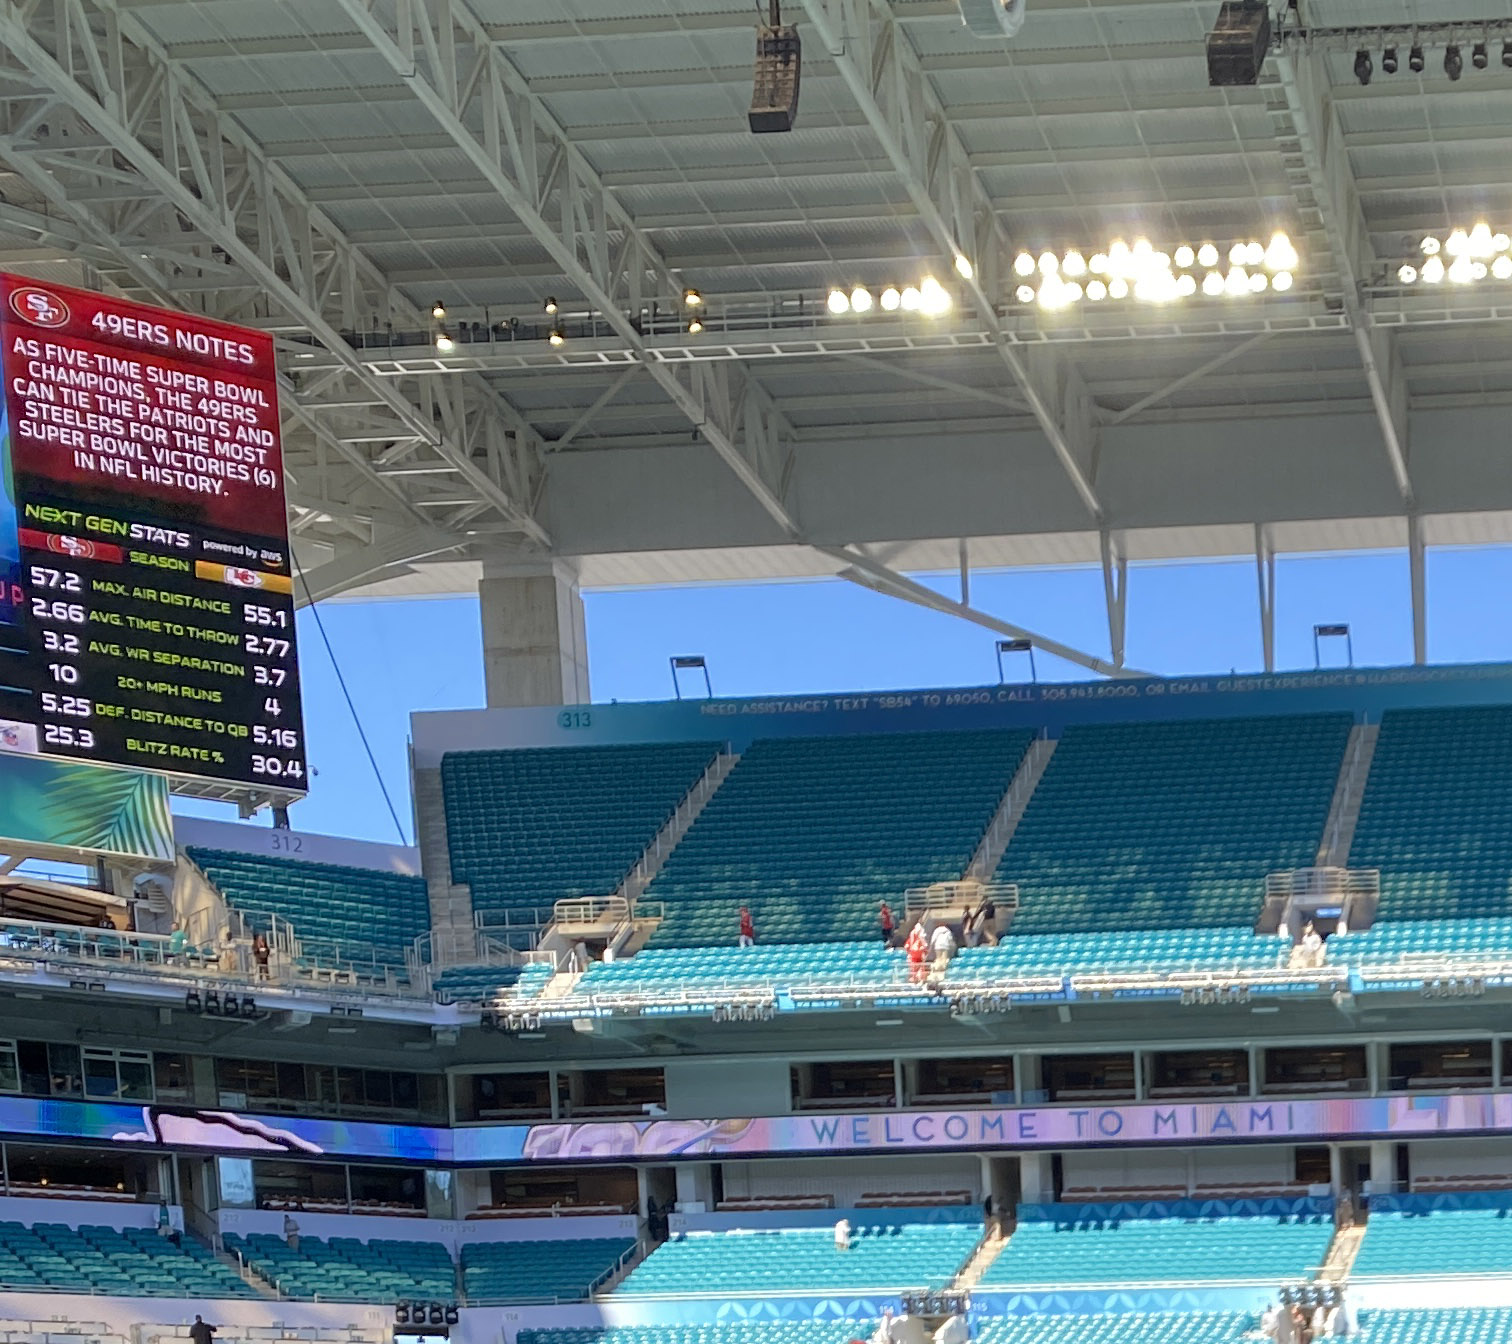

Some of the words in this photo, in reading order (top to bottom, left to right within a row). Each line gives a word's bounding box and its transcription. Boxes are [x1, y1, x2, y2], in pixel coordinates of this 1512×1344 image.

[91, 312, 169, 345] 49ERS
[175, 332, 254, 364] NOTES
[13, 337, 40, 357] AS
[45, 343, 140, 379] FIVE-TIME
[146, 365, 209, 394] SUPER
[215, 380, 269, 407] BOWL
[28, 361, 151, 403] CHAMPIONS,
[155, 388, 192, 410] THE
[197, 397, 257, 424] 49ERS
[13, 378, 54, 401] CAN
[60, 387, 90, 408] TIE
[96, 395, 133, 418] THE
[138, 403, 230, 438] PATRIOTS
[235, 423, 273, 447] AND
[25, 401, 125, 435] STEELERS
[130, 422, 168, 445] FOR
[172, 430, 209, 453] THE
[214, 440, 267, 465] MOST
[19, 420, 85, 447] SUPER
[90, 435, 148, 460] BOWL
[152, 446, 250, 481] VICTORIES
[254, 467, 276, 489] (6)
[74, 450, 95, 470] IN
[100, 458, 137, 479] NFL
[142, 465, 229, 497] HISTORY.
[25, 504, 82, 527] NEXT
[85, 516, 128, 536] GEN
[130, 524, 191, 547] STATS
[203, 539, 244, 556] powered
[246, 544, 258, 559] by
[260, 549, 282, 562] aws
[129, 551, 189, 571] SEASON
[31, 566, 82, 591] 57.2
[93, 579, 129, 597] MAX.
[132, 586, 157, 601] AIR
[160, 591, 231, 614] DISTANCE
[244, 604, 287, 628] 55.1
[32, 597, 85, 624] 2.66
[89, 610, 124, 628] AVG.
[128, 616, 161, 633] TIME
[164, 622, 184, 636] TO
[187, 625, 239, 646] THROW
[245, 634, 289, 657] 2.77
[43, 630, 80, 654] 3.2
[88, 640, 123, 658] AVG.
[126, 647, 150, 662] WR
[152, 651, 245, 677] SEPARATION
[253, 665, 287, 687] 3.7
[49, 663, 78, 684] 10
[117, 676, 144, 690] 20+
[147, 680, 178, 697] MPH
[181, 686, 223, 703] RUNS
[264, 697, 282, 716] 4
[701, 704, 736, 715] NEED
[740, 700, 828, 714] ASSISTANCE?
[834, 698, 867, 710] TEXT
[922, 694, 941, 707] TO
[999, 690, 1035, 702] CALL
[1145, 683, 1166, 695] OR
[1169, 681, 1211, 695] EMAIL
[41, 692, 92, 718] 5.25
[95, 703, 130, 719] DEF.
[131, 708, 202, 731] DISTANCE
[204, 720, 225, 734] TO
[227, 723, 249, 738] QB
[253, 725, 297, 748] 5.16
[562, 711, 592, 728] 313
[45, 724, 95, 749] 25.3
[126, 738, 168, 756] BLITZ
[170, 744, 209, 761] RATE
[211, 750, 225, 764] %
[251, 754, 303, 778] 30.4
[271, 833, 303, 853] 312
[810, 1112, 1038, 1146] WELCOME
[1067, 1108, 1125, 1138] TO
[1153, 1102, 1296, 1136] MIAMI
